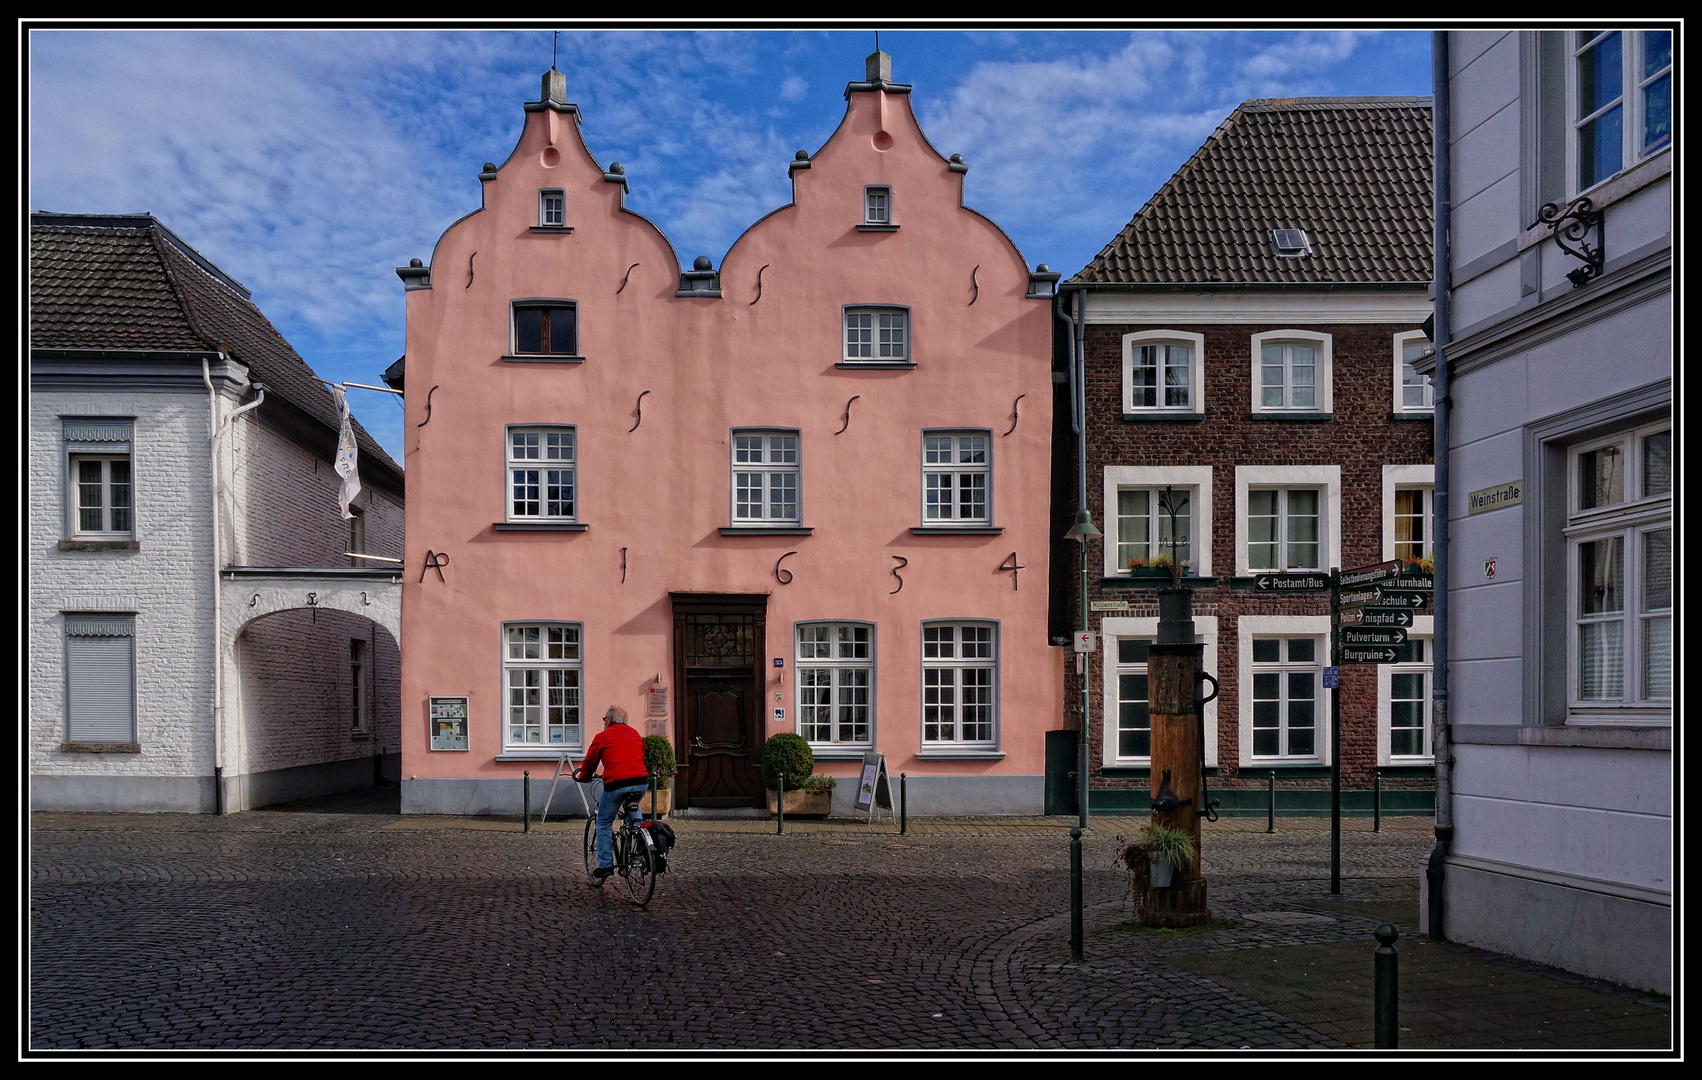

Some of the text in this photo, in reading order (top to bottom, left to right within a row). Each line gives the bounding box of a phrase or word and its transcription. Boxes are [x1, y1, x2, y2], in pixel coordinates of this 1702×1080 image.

[1471, 485, 1519, 508] Weinstraße
[775, 551, 798, 584] 6
[889, 555, 908, 594] 3
[999, 552, 1026, 591] 4
[1273, 577, 1324, 588] Postamt/Bus
[1340, 591, 1373, 605] Sportanlagen
[1341, 611, 1356, 623] Polizei
[1365, 613, 1395, 625] nispfad
[1346, 632, 1390, 642] Pulverturm
[1344, 649, 1383, 661] Burgruine
